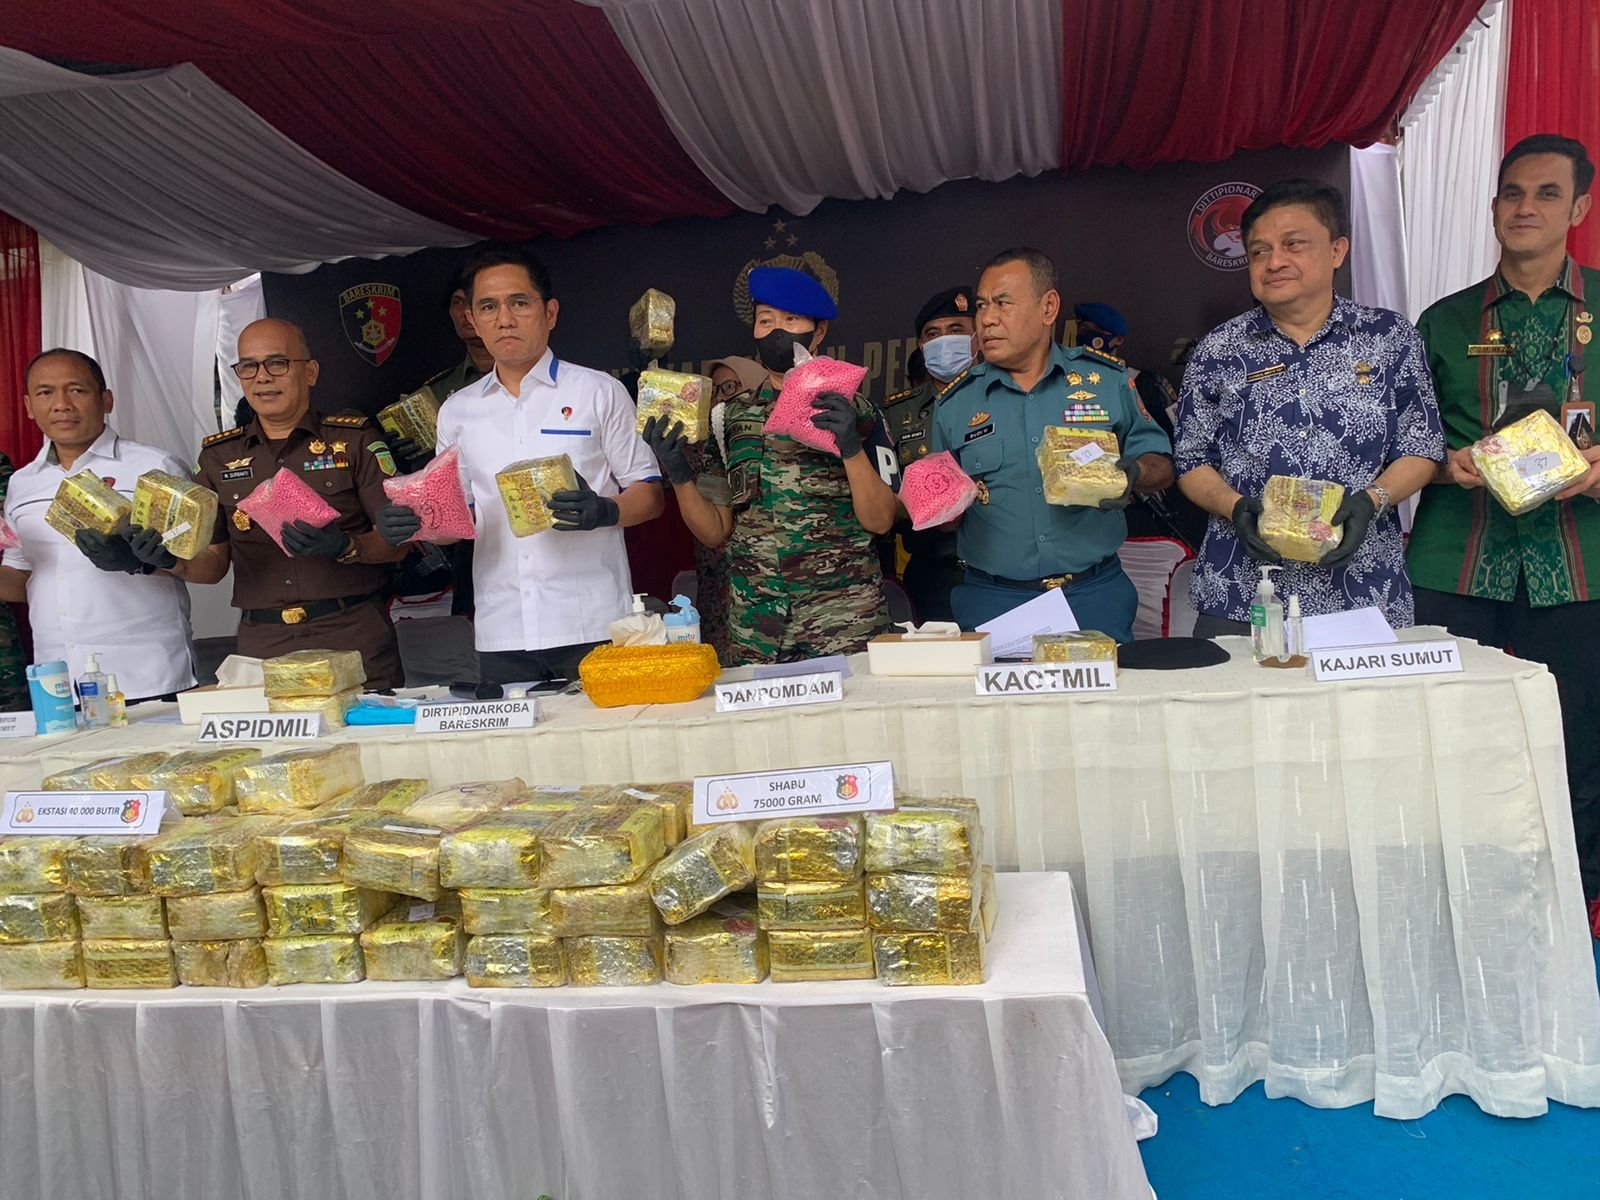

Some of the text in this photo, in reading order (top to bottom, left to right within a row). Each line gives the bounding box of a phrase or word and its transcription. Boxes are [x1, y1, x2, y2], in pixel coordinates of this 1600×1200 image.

[1196, 185, 1260, 212] DITTIPIDNAR
[1206, 252, 1248, 267] BARESKRI
[343, 285, 395, 302] BARESKRIM
[677, 632, 696, 641] mitu
[1320, 649, 1453, 673] KAJARI SUMUT
[722, 680, 835, 704] DANPOMDAM
[422, 703, 530, 718] DIRTIPIDNARKOBA
[440, 717, 509, 730] BARESKRIM
[769, 779, 806, 792] SHABU
[753, 794, 822, 809] 75000 GRAM
[37, 806, 120, 816] EKSTASI 40.000 BUTIR
